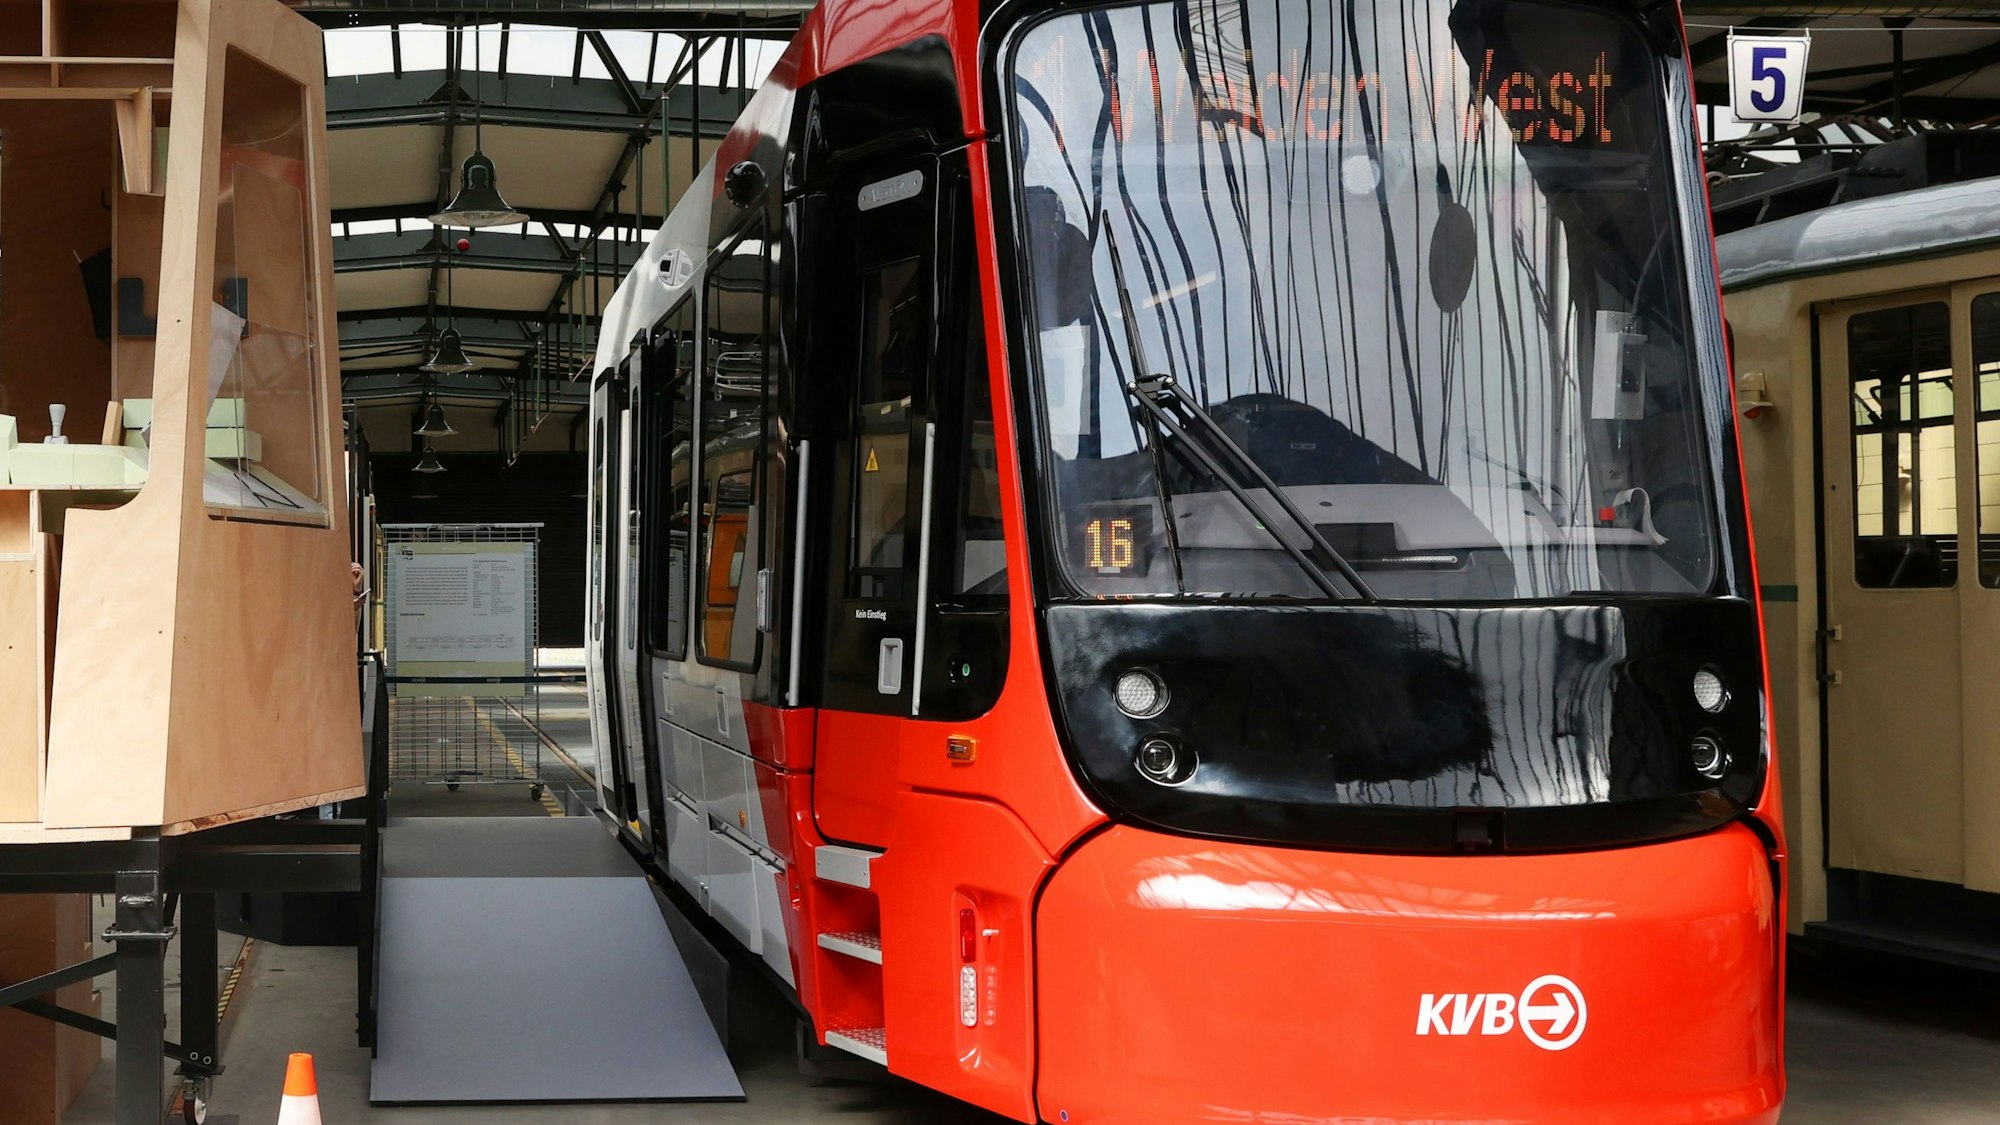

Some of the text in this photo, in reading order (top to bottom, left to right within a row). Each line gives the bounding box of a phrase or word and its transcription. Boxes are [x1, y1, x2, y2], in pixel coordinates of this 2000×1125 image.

[1102, 48, 1388, 143] Weiden
[1407, 48, 1613, 142] West
[1750, 47, 1787, 113] 5
[1087, 519, 1131, 568] 16
[855, 609, 887, 621] Kein Einstieg
[1415, 993, 1516, 1036] KVB
